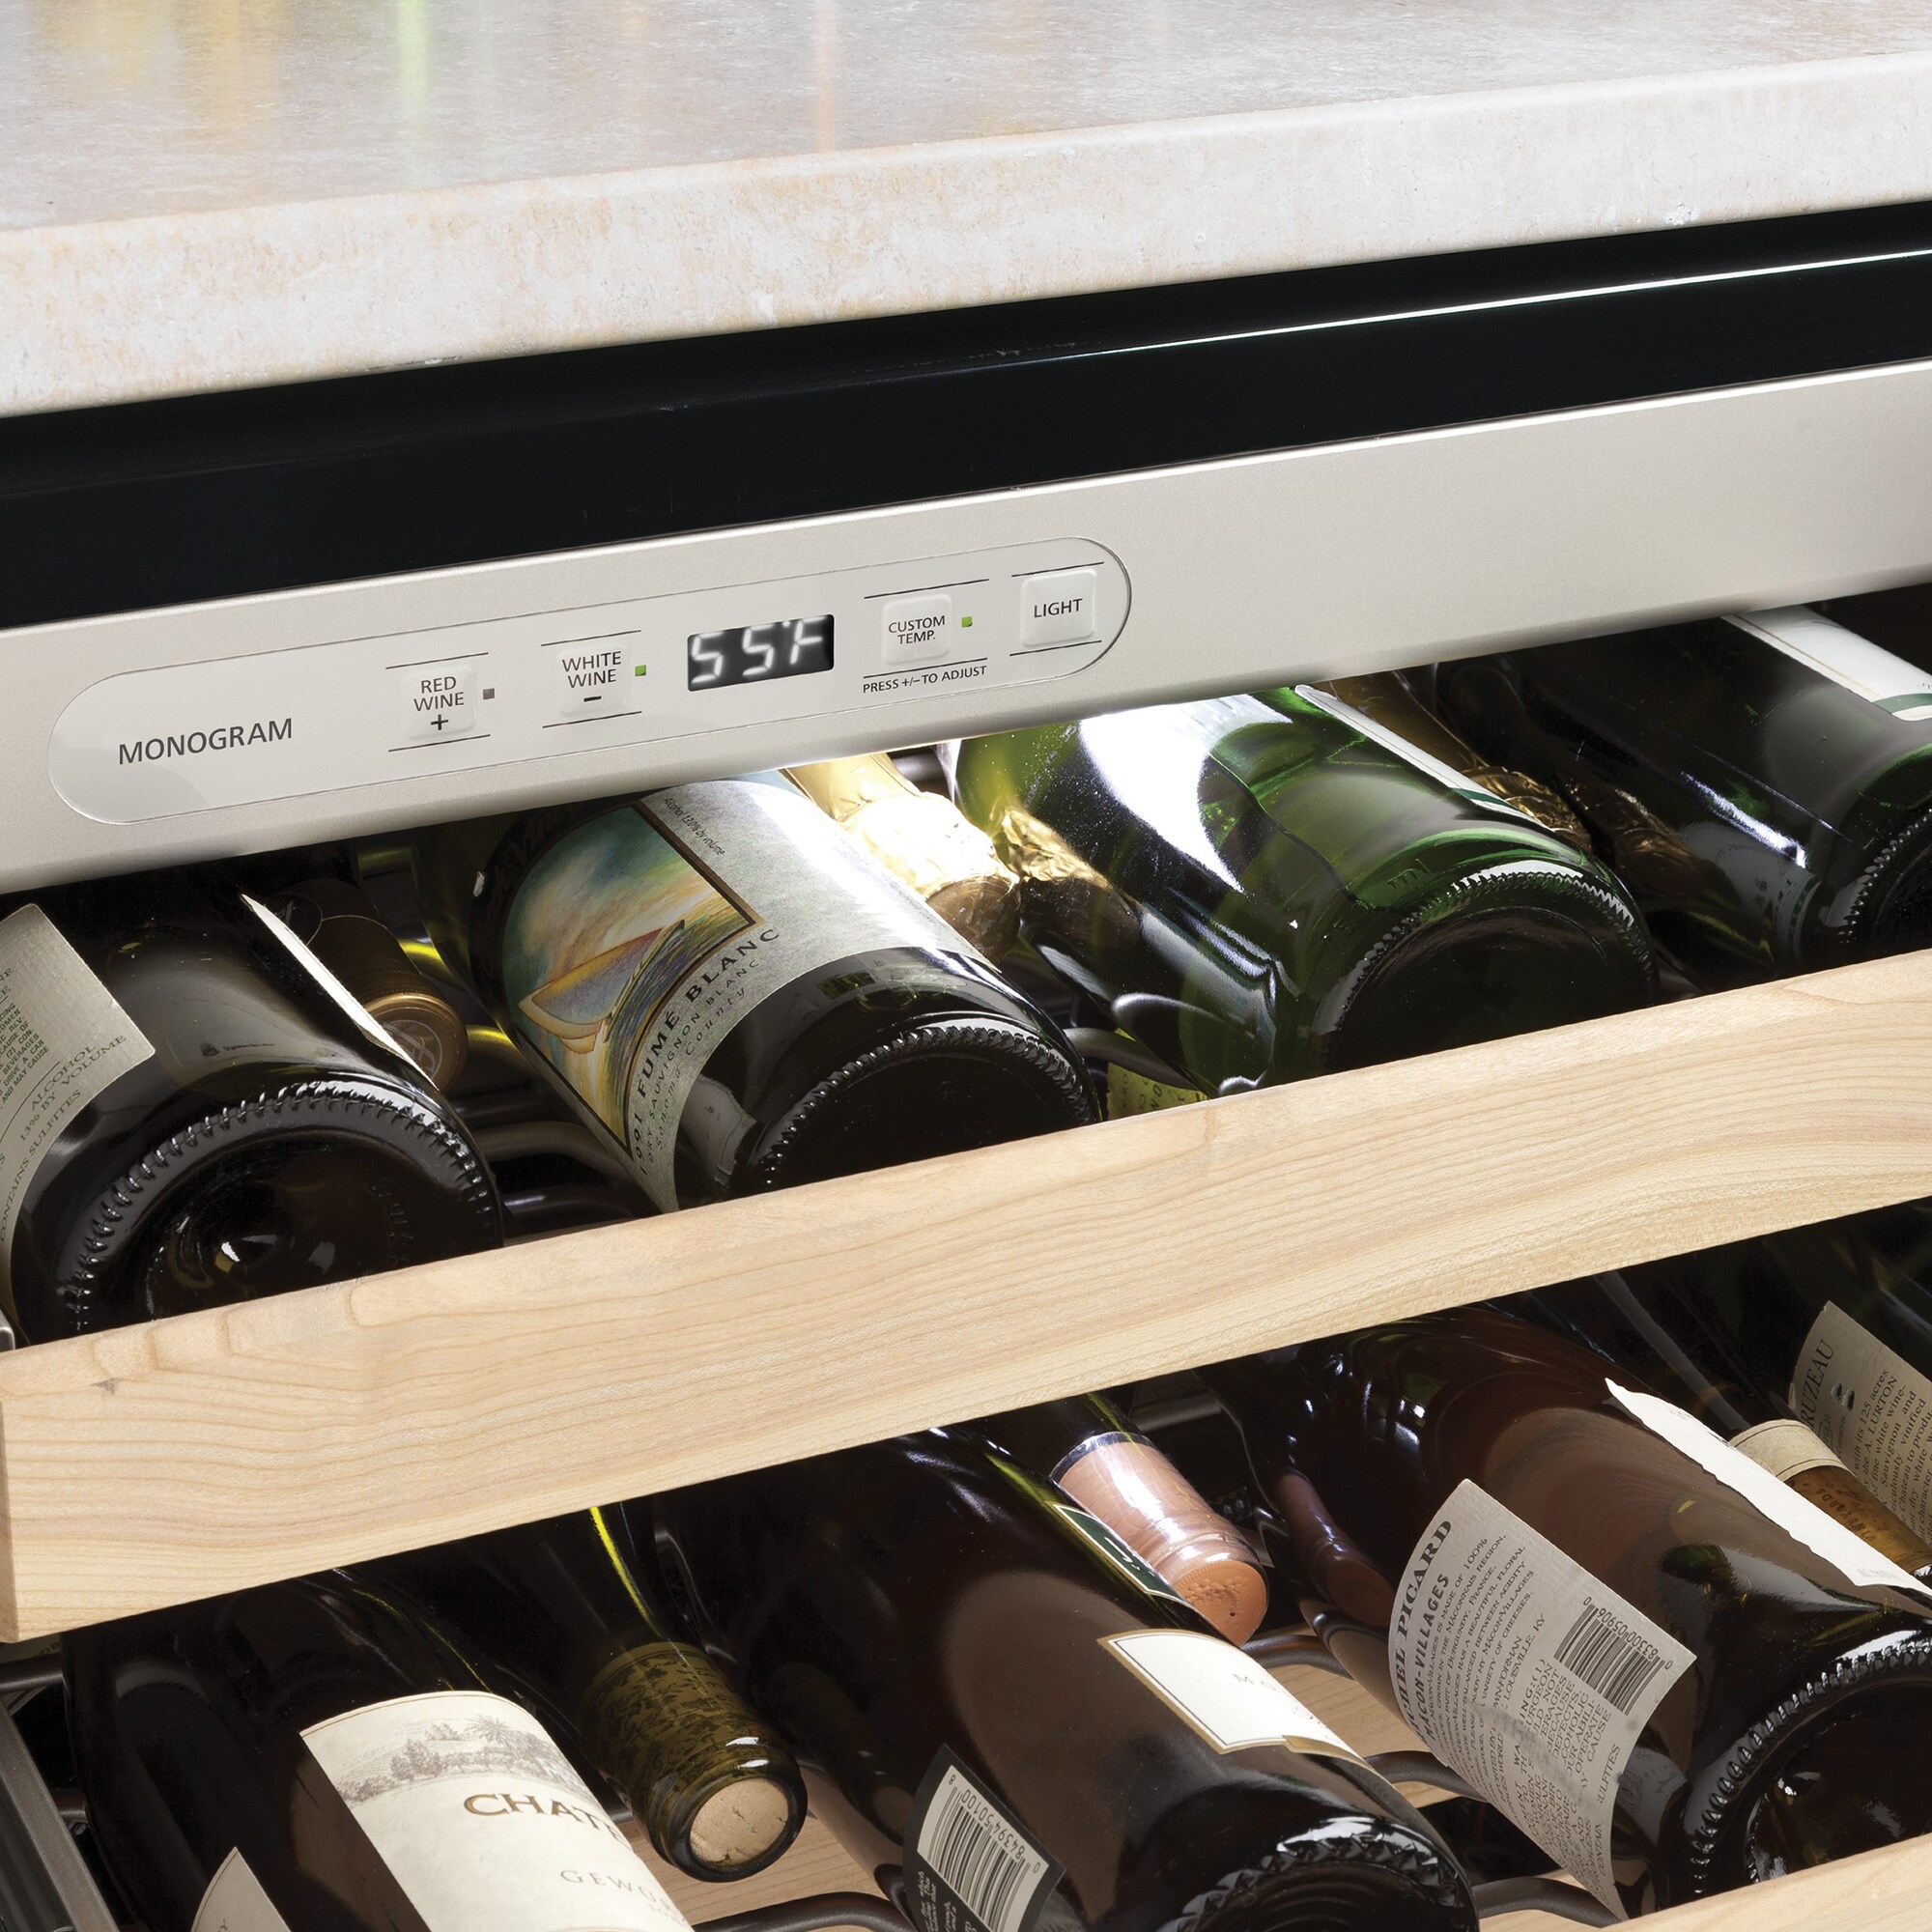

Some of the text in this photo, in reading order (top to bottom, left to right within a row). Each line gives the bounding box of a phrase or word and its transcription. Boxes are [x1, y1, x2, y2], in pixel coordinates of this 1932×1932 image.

[888, 614, 946, 634] CUSTOM
[1033, 598, 1084, 618] LIGHT
[561, 650, 621, 672] WHITE
[896, 630, 936, 645] TEMP.
[413, 692, 465, 712] WINE
[420, 676, 457, 694] RED
[567, 668, 617, 689] WINE
[863, 678, 899, 694] PRESS
[922, 672, 938, 685] TO
[941, 665, 987, 681] ADJUST
[119, 718, 292, 765] MONOGRAM
[0, 1009, 20, 1033] OMEN
[19, 1020, 29, 1032] OF
[638, 1009, 680, 1098] FUMÉ
[685, 928, 780, 1003] BLANC
[649, 1012, 700, 1120] SAUVIGNON
[706, 959, 759, 1006] BLANC
[686, 987, 746, 1056] County
[2, 1045, 49, 1103] AND MAY CAUSE
[3, 1033, 40, 1075] BEVERAGES
[30, 1039, 44, 1055] CAR
[41, 1092, 57, 1111] BY
[61, 1035, 127, 1087] VOLUME
[31, 1044, 97, 1111] ALCOHOL
[29, 1089, 81, 1156] SULFITES
[1800, 1339, 1833, 1428] RUZEAU
[1860, 1402, 1871, 1425] 125
[1870, 1370, 1889, 1401] acres
[1868, 1376, 1898, 1435] LURTON
[1881, 1391, 1917, 1487] Sauvignon and
[1901, 1398, 1926, 1445] vinified
[1871, 1459, 1880, 1482] fine
[1876, 1421, 1889, 1454] white
[1907, 1449, 1915, 1463] to
[1909, 1488, 1918, 1509] dry
[1914, 1449, 1928, 1483] white
[1397, 1520, 1451, 1642] PICARD
[1436, 1623, 1443, 1634] IS
[1441, 1591, 1456, 1620] MADE
[1455, 1573, 1463, 1588] OF
[1463, 1539, 1488, 1570] 100%
[1458, 1649, 1466, 1670] HAS
[1468, 1584, 1497, 1636] BEAUTIFUL
[1496, 1547, 1525, 1581] FLORAL
[1475, 1600, 1499, 1648] BETWEEN
[1499, 1561, 1525, 1599] ACIDITY
[1482, 1657, 1496, 1699] VARIETY
[1494, 1640, 1502, 1656] OF
[1502, 1592, 1534, 1638] CHEESES.
[1533, 1613, 1545, 1633] KY
[1582, 1596, 1673, 1670] 0 83300 05906 0
[1439, 1659, 1444, 1671] IN
[1446, 1671, 1452, 1686] OF
[1478, 1657, 1486, 1674] MY
[1543, 1669, 1559, 1701] NOT
[1526, 1662, 1552, 1727] URGEON
[1540, 1676, 1567, 1739] ERAGES
[1561, 1692, 1589, 1762] COHOLIC
[1576, 1704, 1605, 1774] OPERATE
[1587, 1710, 1611, 1763] CAUSE
[948, 1774, 1041, 1874] 0 84394 50100 8
